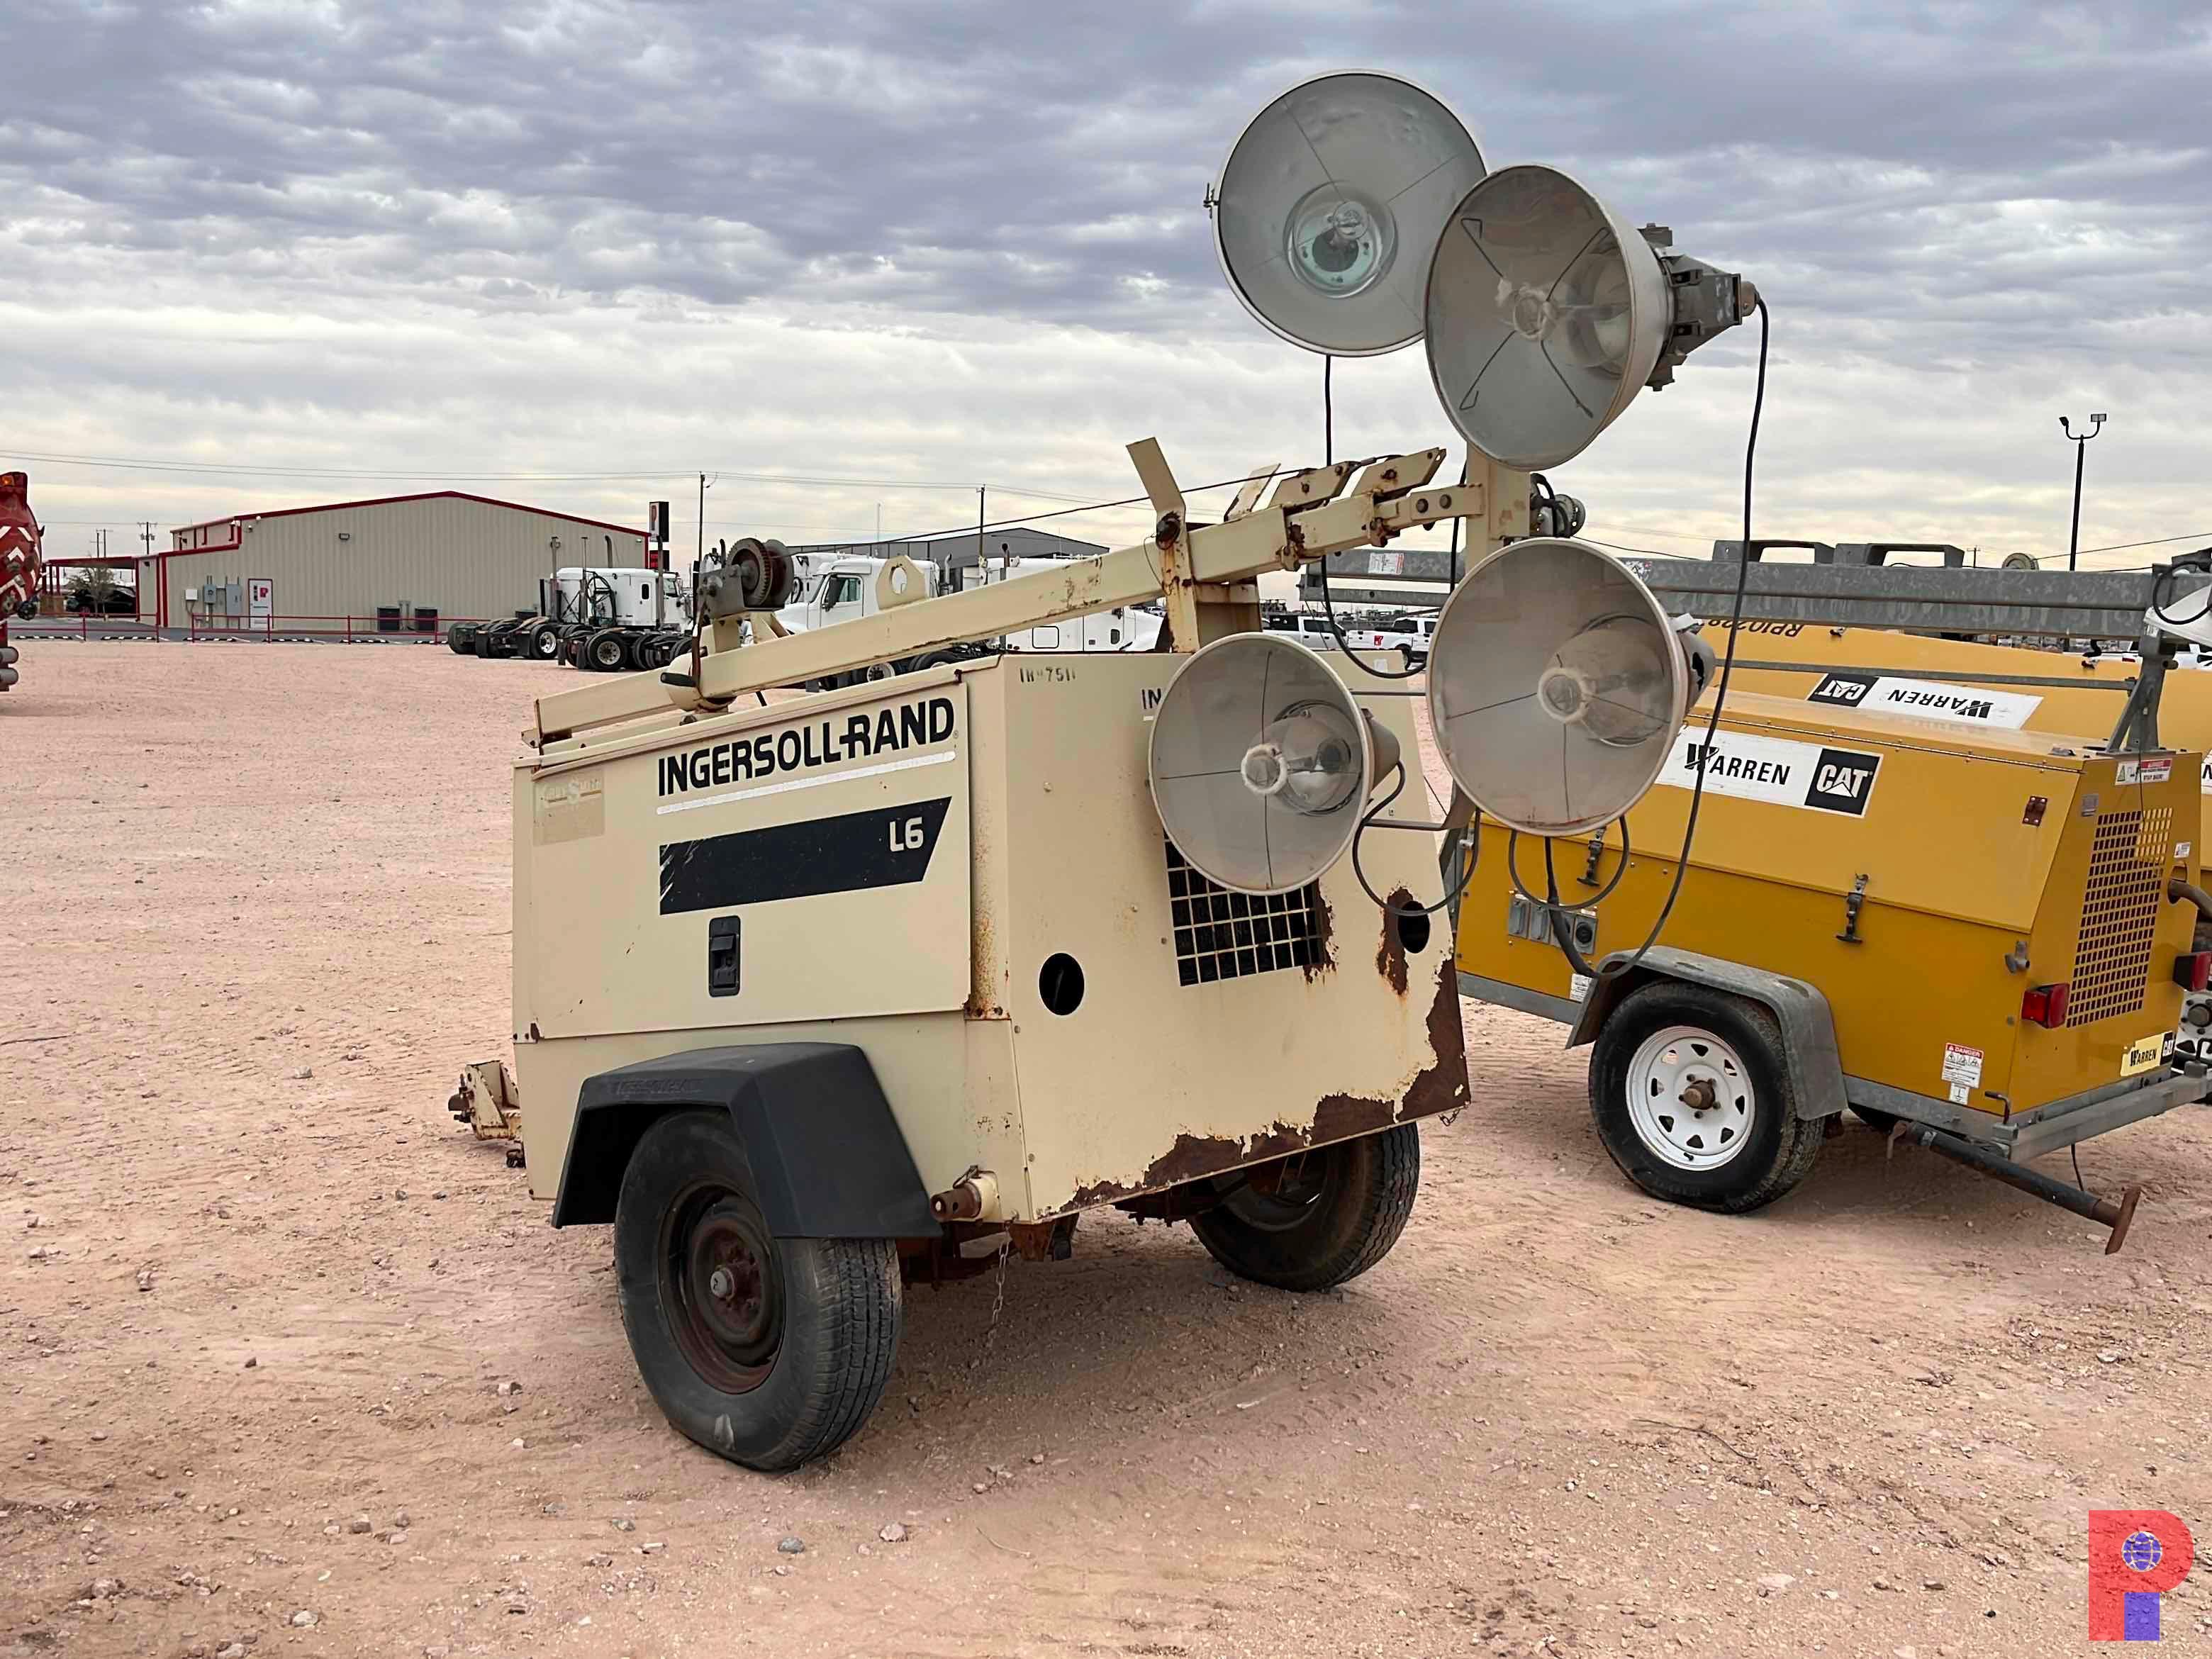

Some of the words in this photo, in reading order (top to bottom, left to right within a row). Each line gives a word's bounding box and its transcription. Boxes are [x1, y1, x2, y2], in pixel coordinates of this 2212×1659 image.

[1815, 680, 1867, 700] CAT
[1887, 689, 1994, 719] WARREN
[659, 698, 955, 796] INGERSOLL-RAND
[1684, 743, 1791, 786] WARREN
[1816, 764, 1869, 798] CAT
[889, 816, 924, 852] L6
[2130, 1049, 2157, 1067] WARREN
[2162, 1039, 2174, 1057] CAT
